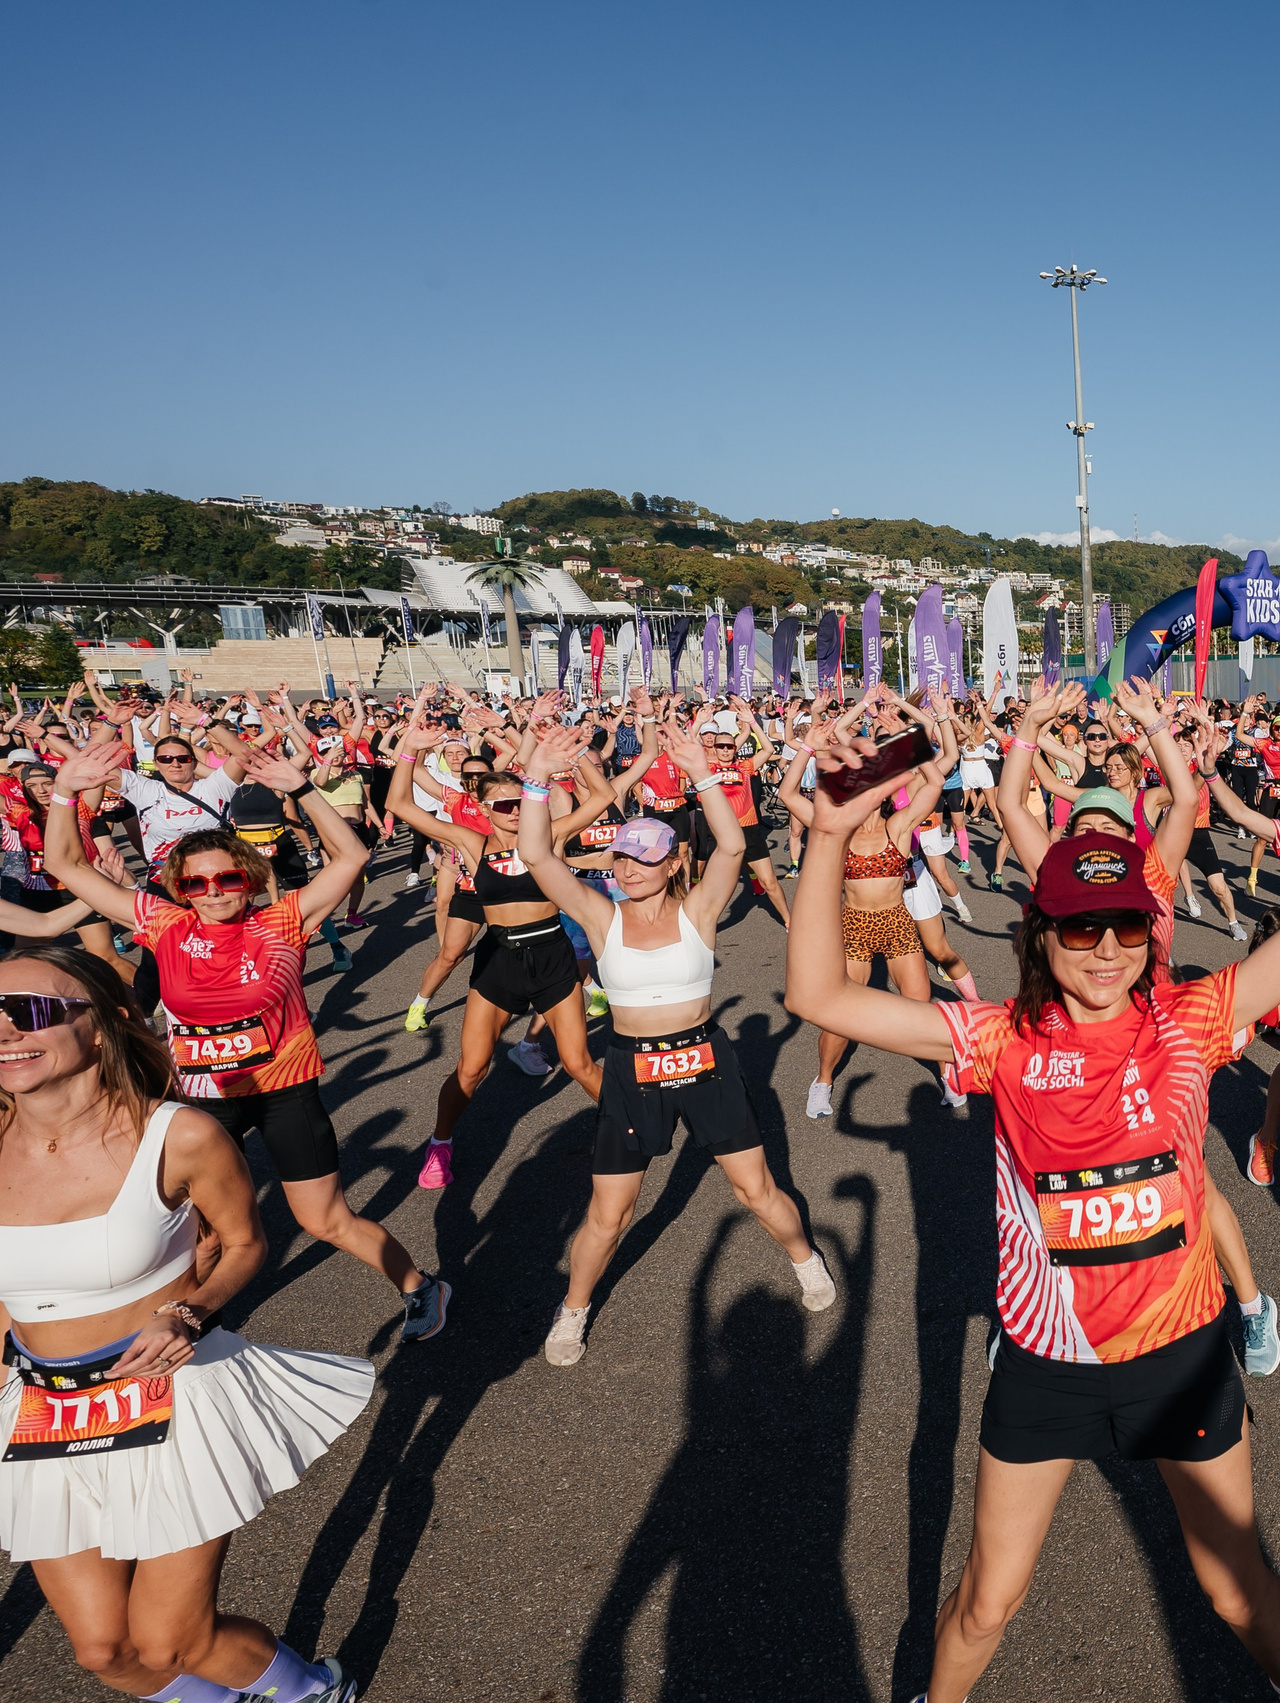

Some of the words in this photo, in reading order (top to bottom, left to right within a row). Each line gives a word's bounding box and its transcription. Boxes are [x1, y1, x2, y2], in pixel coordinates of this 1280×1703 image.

[1246, 578, 1273, 598] STAR
[1246, 598, 1280, 624] KIDS
[1171, 613, 1196, 636] сбп
[738, 644, 747, 667] KIDS
[868, 636, 876, 662] KIDS
[923, 635, 935, 662] KIDS
[951, 679, 959, 699] STAR
[738, 746, 754, 756] STAR
[658, 799, 676, 809] 7417
[587, 826, 617, 842] 7627
[586, 869, 614, 879] EAZY
[1076, 861, 1127, 880] Мурманск
[185, 1034, 253, 1061] 7429
[210, 1061, 239, 1072] МАРИЯ
[647, 1050, 703, 1076] 7632
[659, 1076, 697, 1088] АНАСТАСИЯ
[1049, 1075, 1085, 1089] SOCHI
[1122, 1065, 1141, 1088] ADY
[1129, 1128, 1147, 1139] SIRIUS
[1147, 1124, 1164, 1135] SOCHI
[1050, 1180, 1068, 1190] LADY
[1078, 1170, 1095, 1185] 10
[1060, 1186, 1162, 1238] 7929
[66, 1436, 115, 1453] ЮЛЛИЯ
